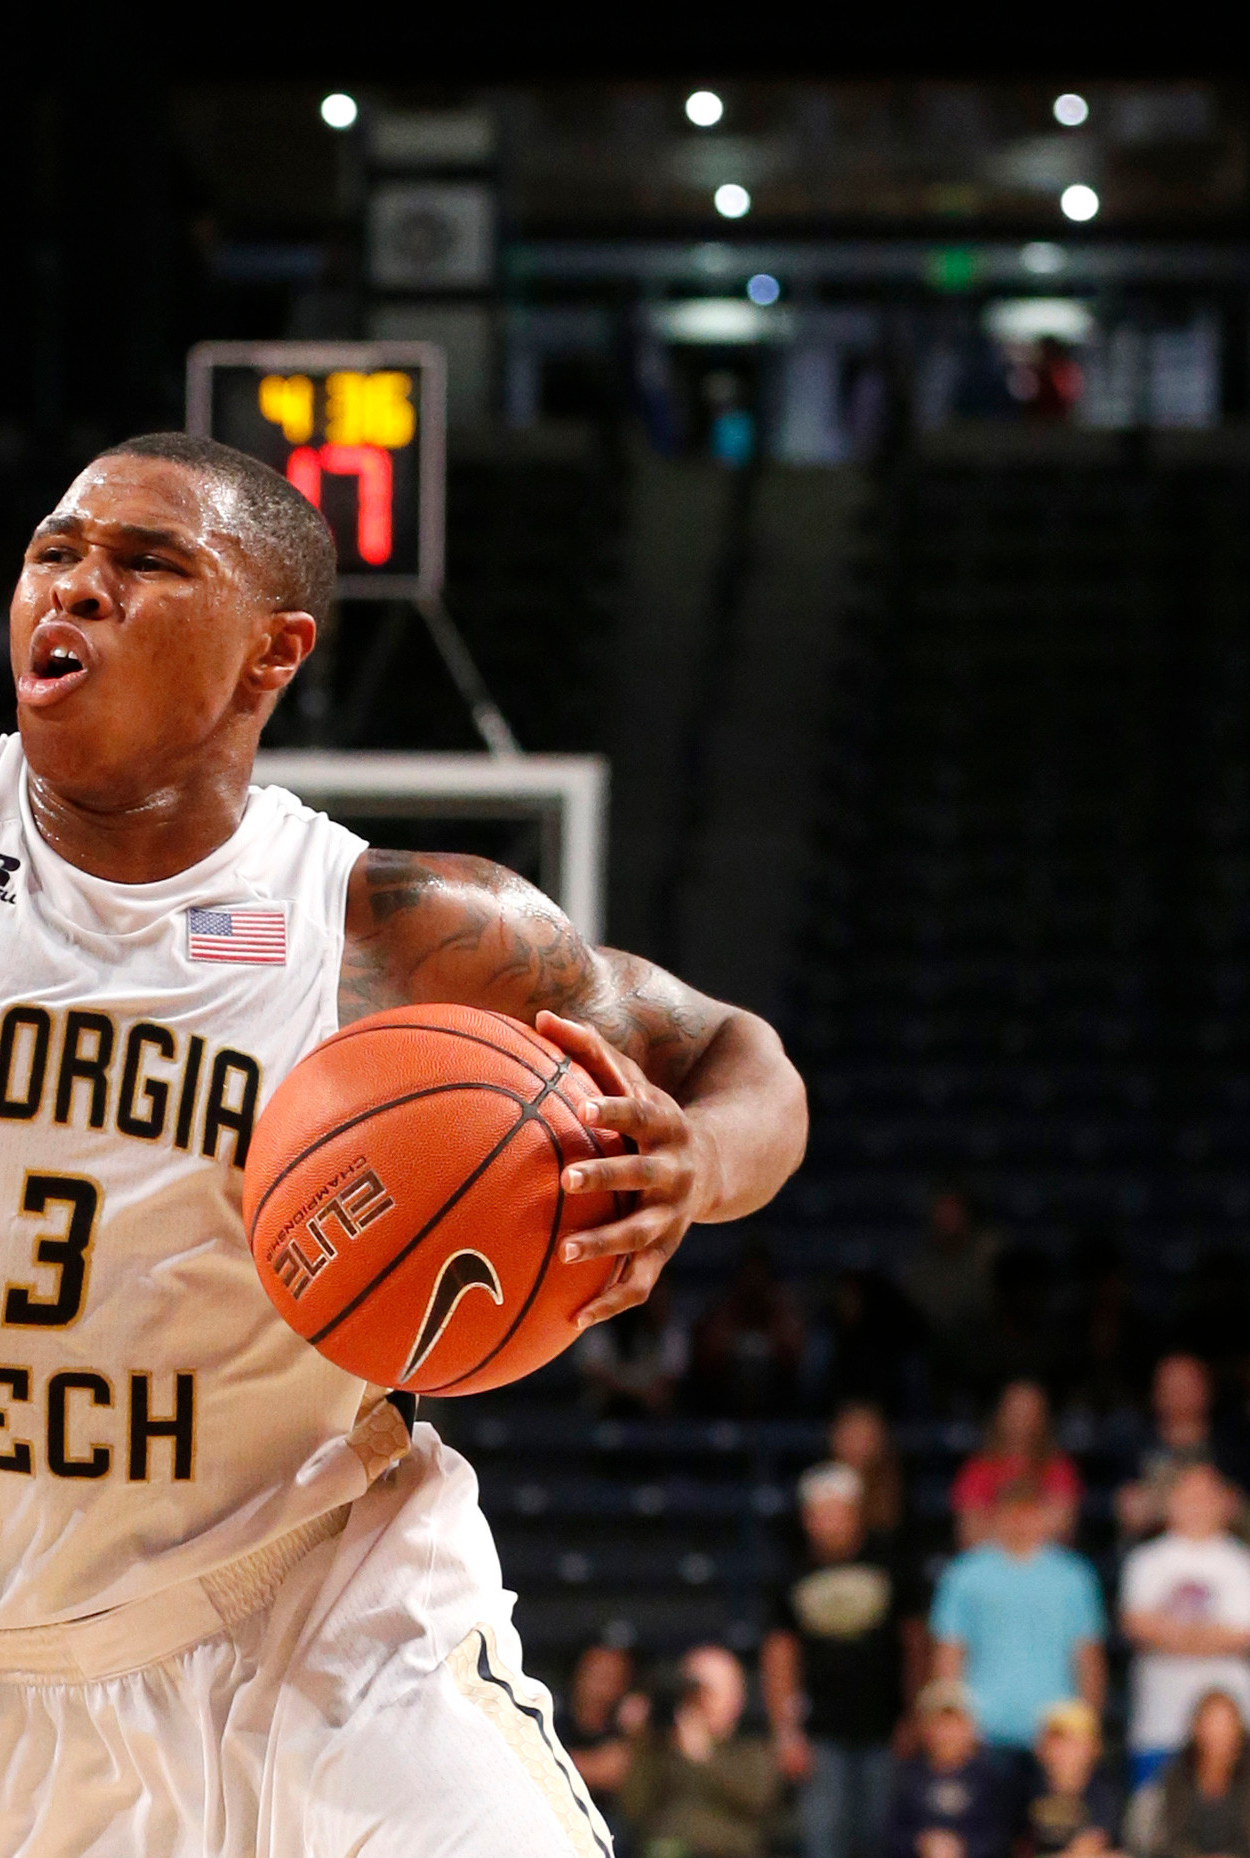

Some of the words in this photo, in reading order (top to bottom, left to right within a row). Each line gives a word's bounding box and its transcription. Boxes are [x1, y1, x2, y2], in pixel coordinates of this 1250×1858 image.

[260, 375, 314, 444] 4
[0, 1167, 105, 1330] 3
[265, 1155, 368, 1263] CHAMPIONSHIP
[272, 1168, 396, 1302] ELITE
